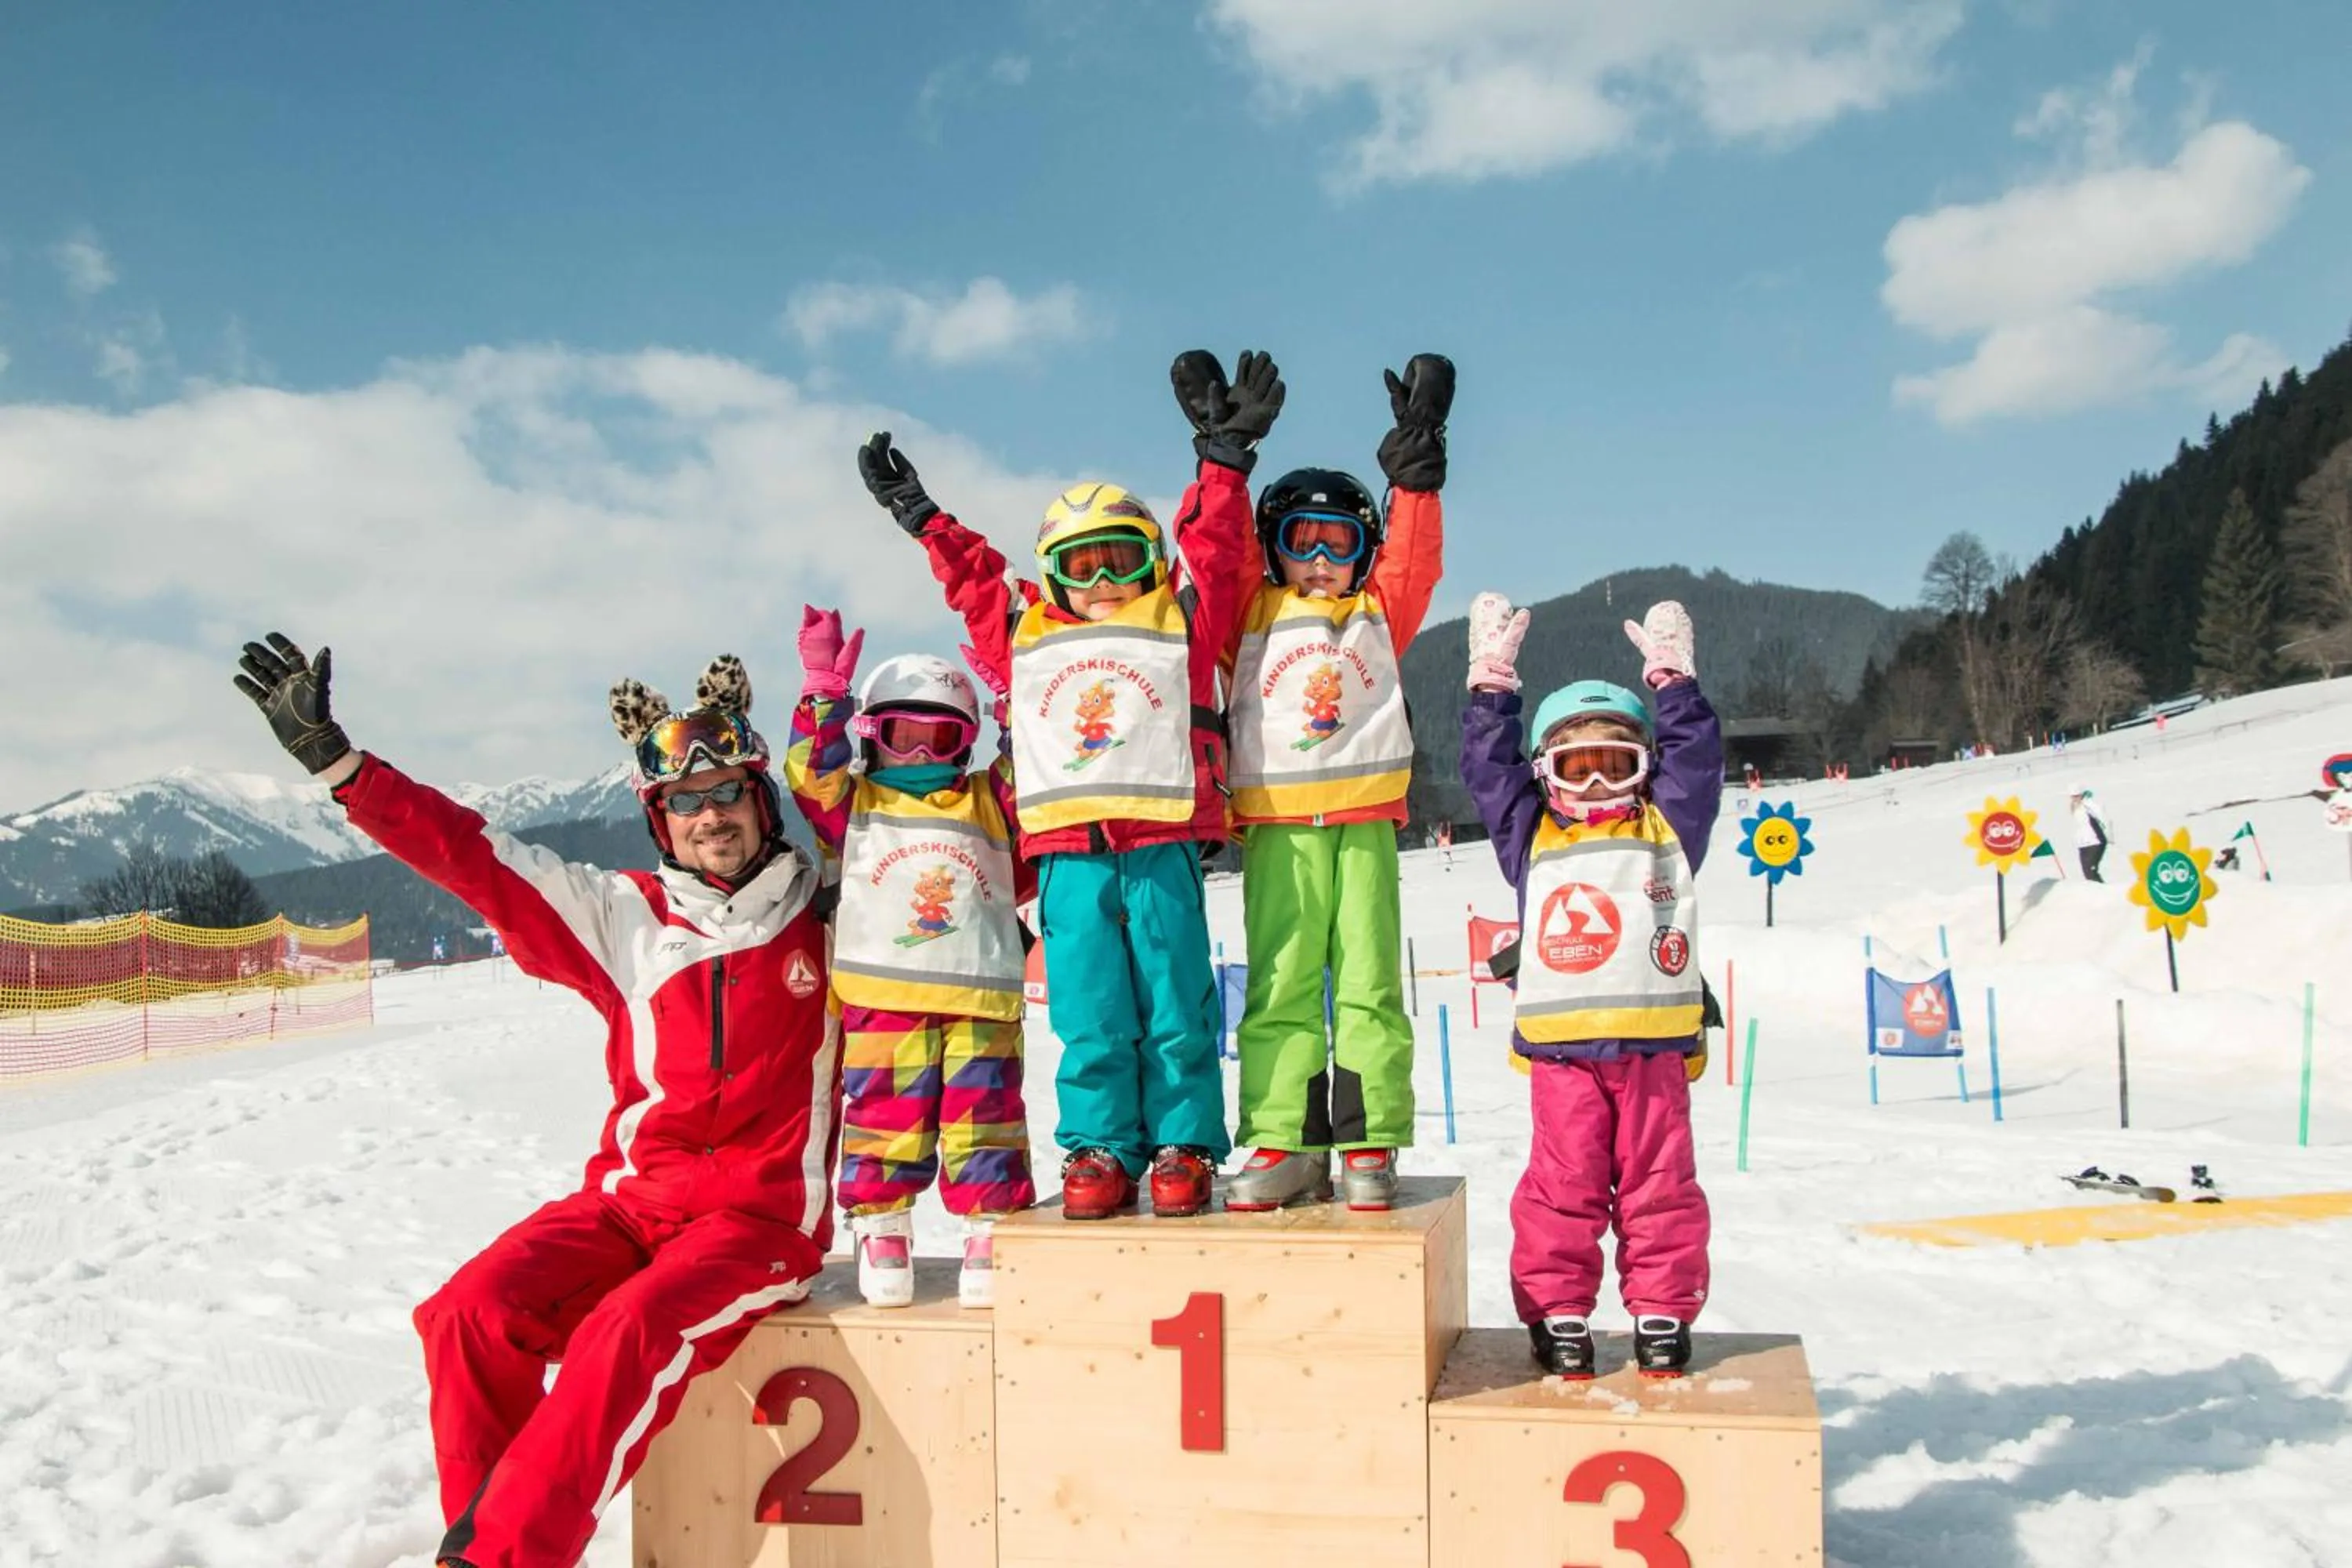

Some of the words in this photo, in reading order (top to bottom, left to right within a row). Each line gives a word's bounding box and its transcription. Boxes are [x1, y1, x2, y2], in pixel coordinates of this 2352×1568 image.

[1039, 659, 1163, 717] KINDERSKISCHULE
[871, 842, 993, 901] KINDERSKISCHULE
[1548, 944, 1602, 959] EBEN
[1152, 1292, 1224, 1453] 1
[753, 1367, 863, 1526] 2
[1563, 1450, 1691, 1568] 3
